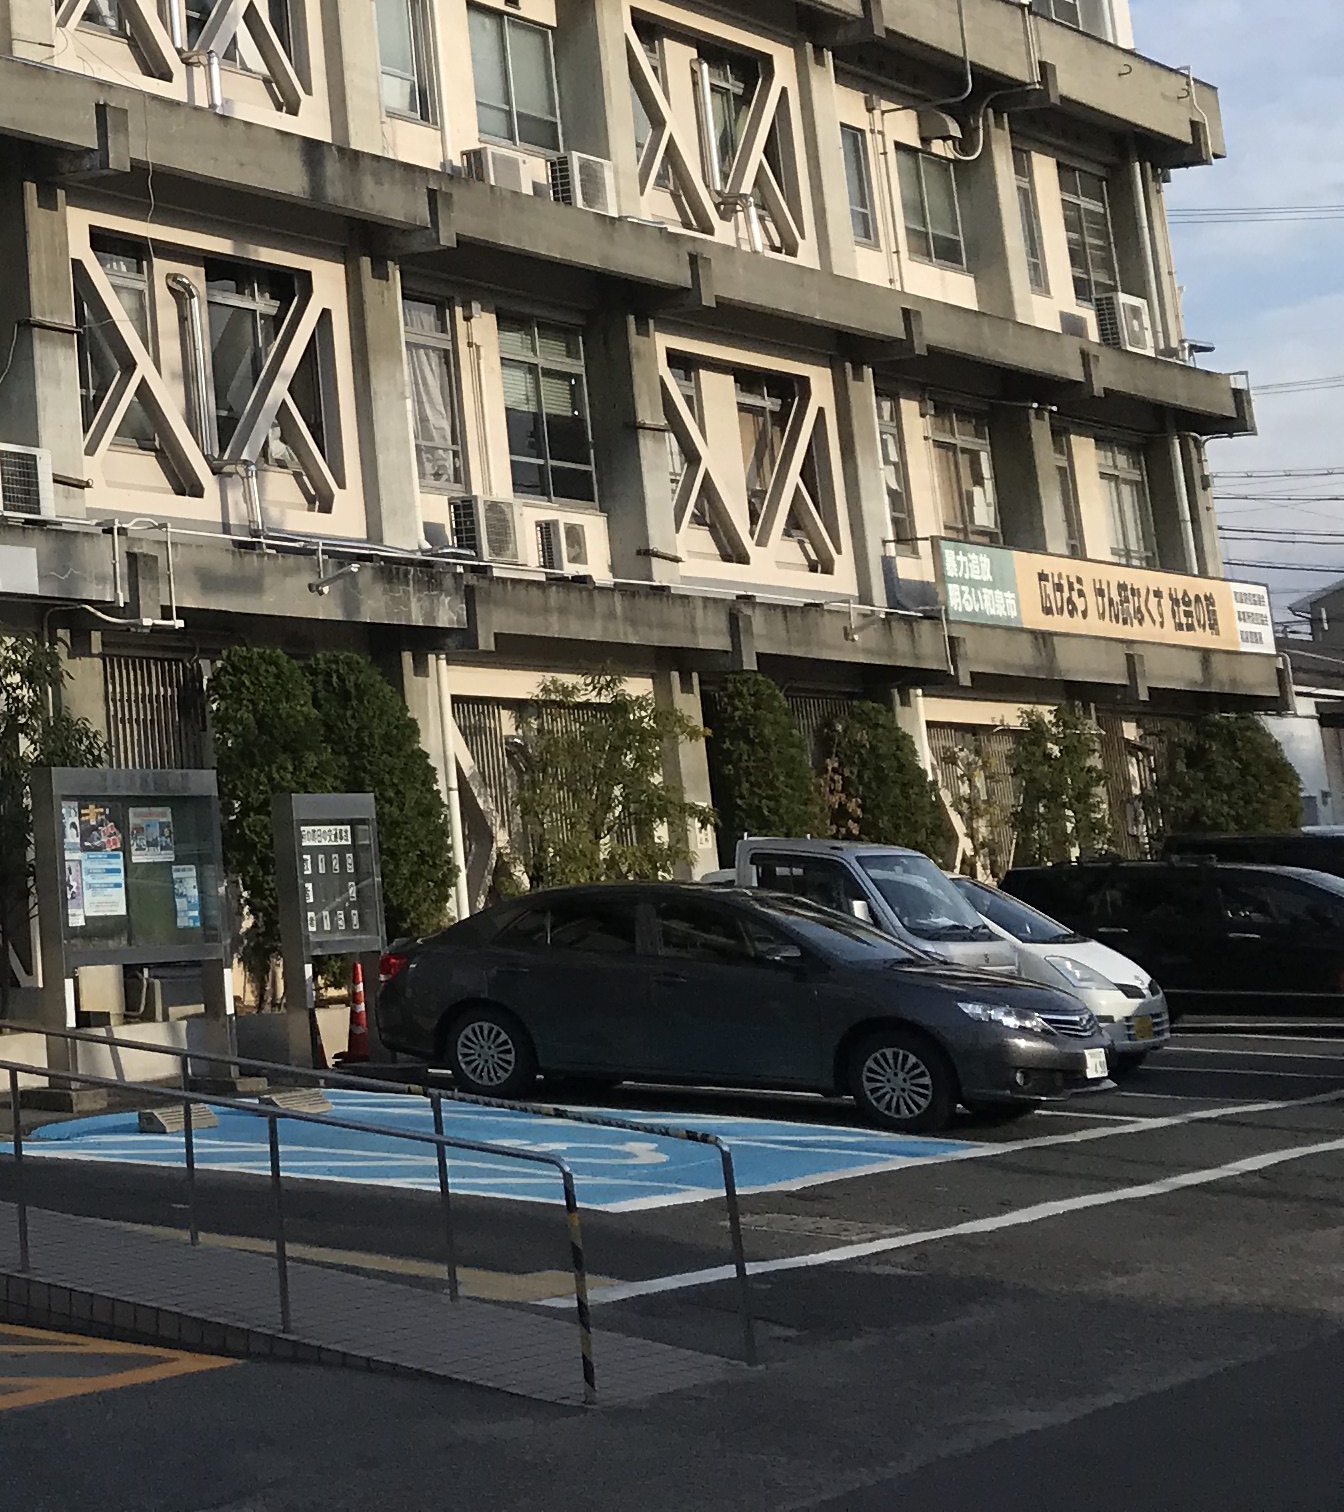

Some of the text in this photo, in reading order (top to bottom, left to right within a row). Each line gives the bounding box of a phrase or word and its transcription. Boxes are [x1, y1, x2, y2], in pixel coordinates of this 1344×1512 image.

[944, 548, 993, 581] 暴力追放
[948, 586, 1017, 618] 明るい和泉市
[1037, 569, 1088, 620] 広げよう
